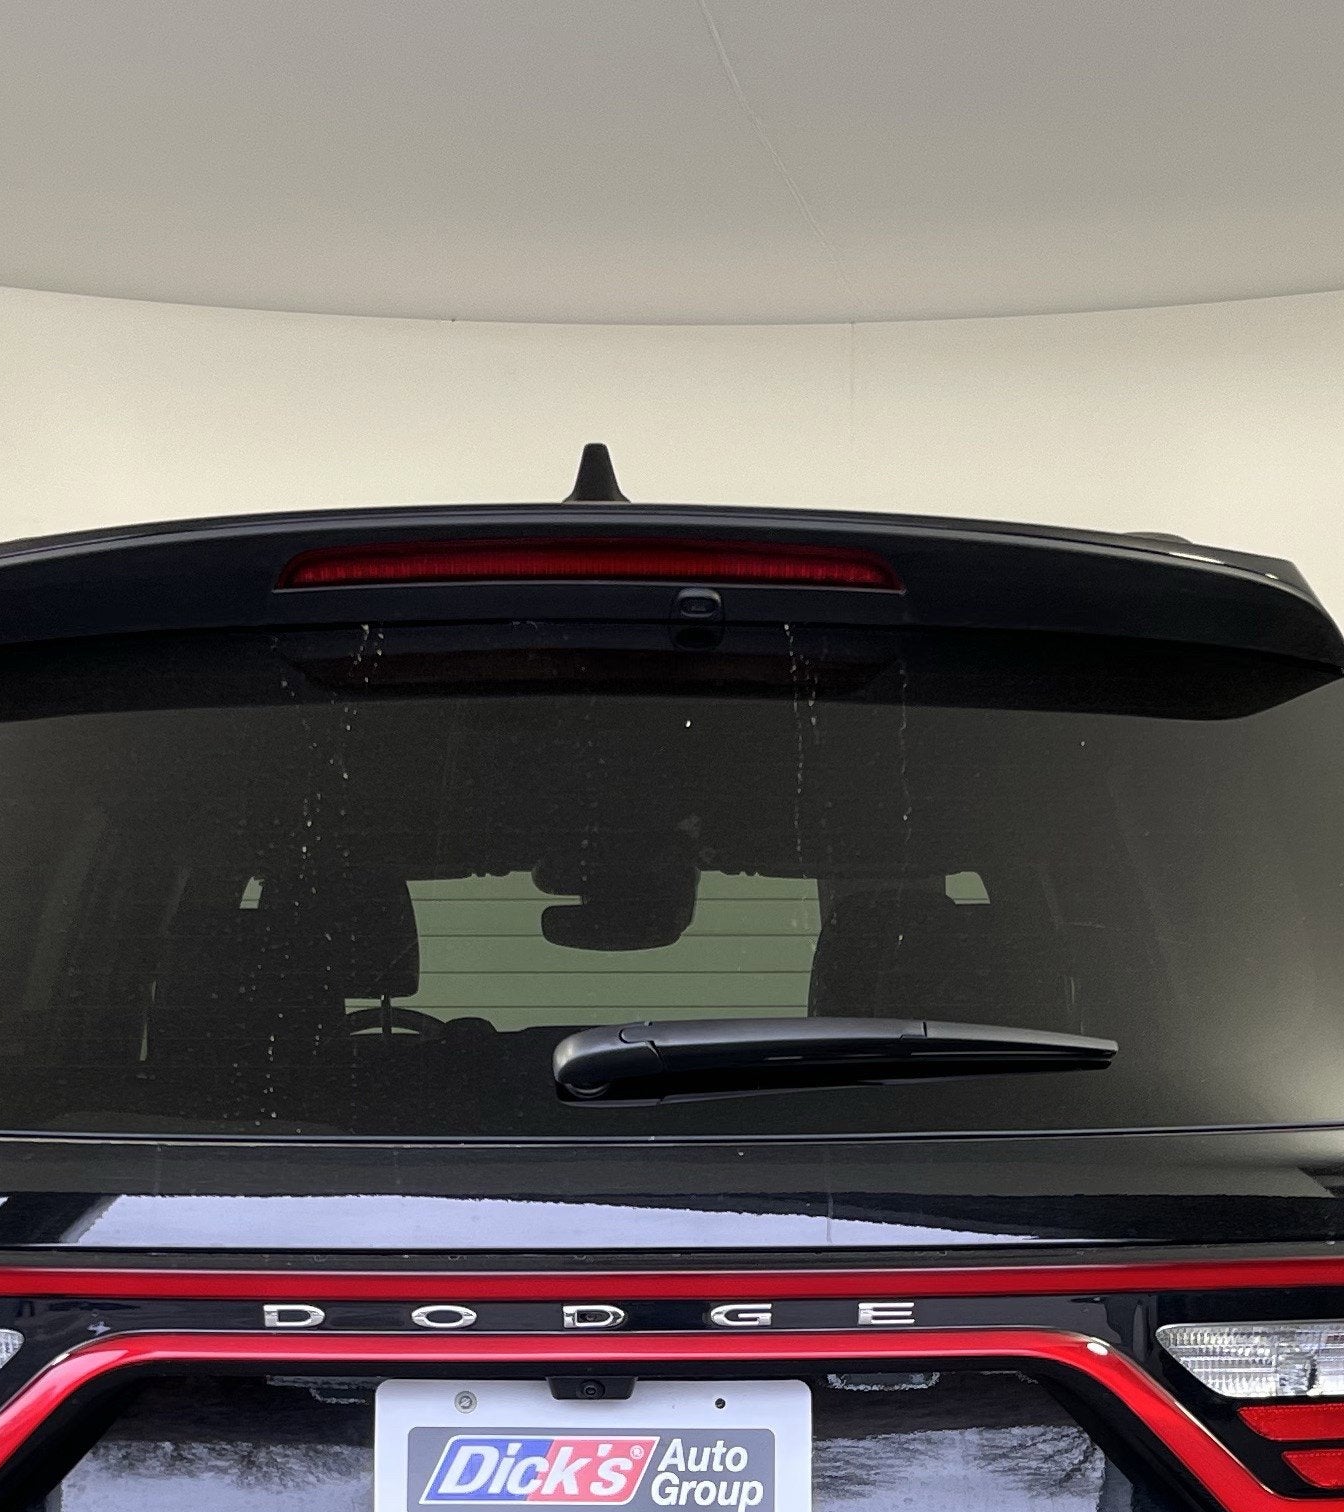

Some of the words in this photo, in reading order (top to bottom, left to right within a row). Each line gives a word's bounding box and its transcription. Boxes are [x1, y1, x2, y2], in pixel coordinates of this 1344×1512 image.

[263, 1302, 915, 1329] DODGE
[437, 1442, 634, 1496] Dick's
[657, 1438, 749, 1472] Auto
[651, 1472, 764, 1512] Group
